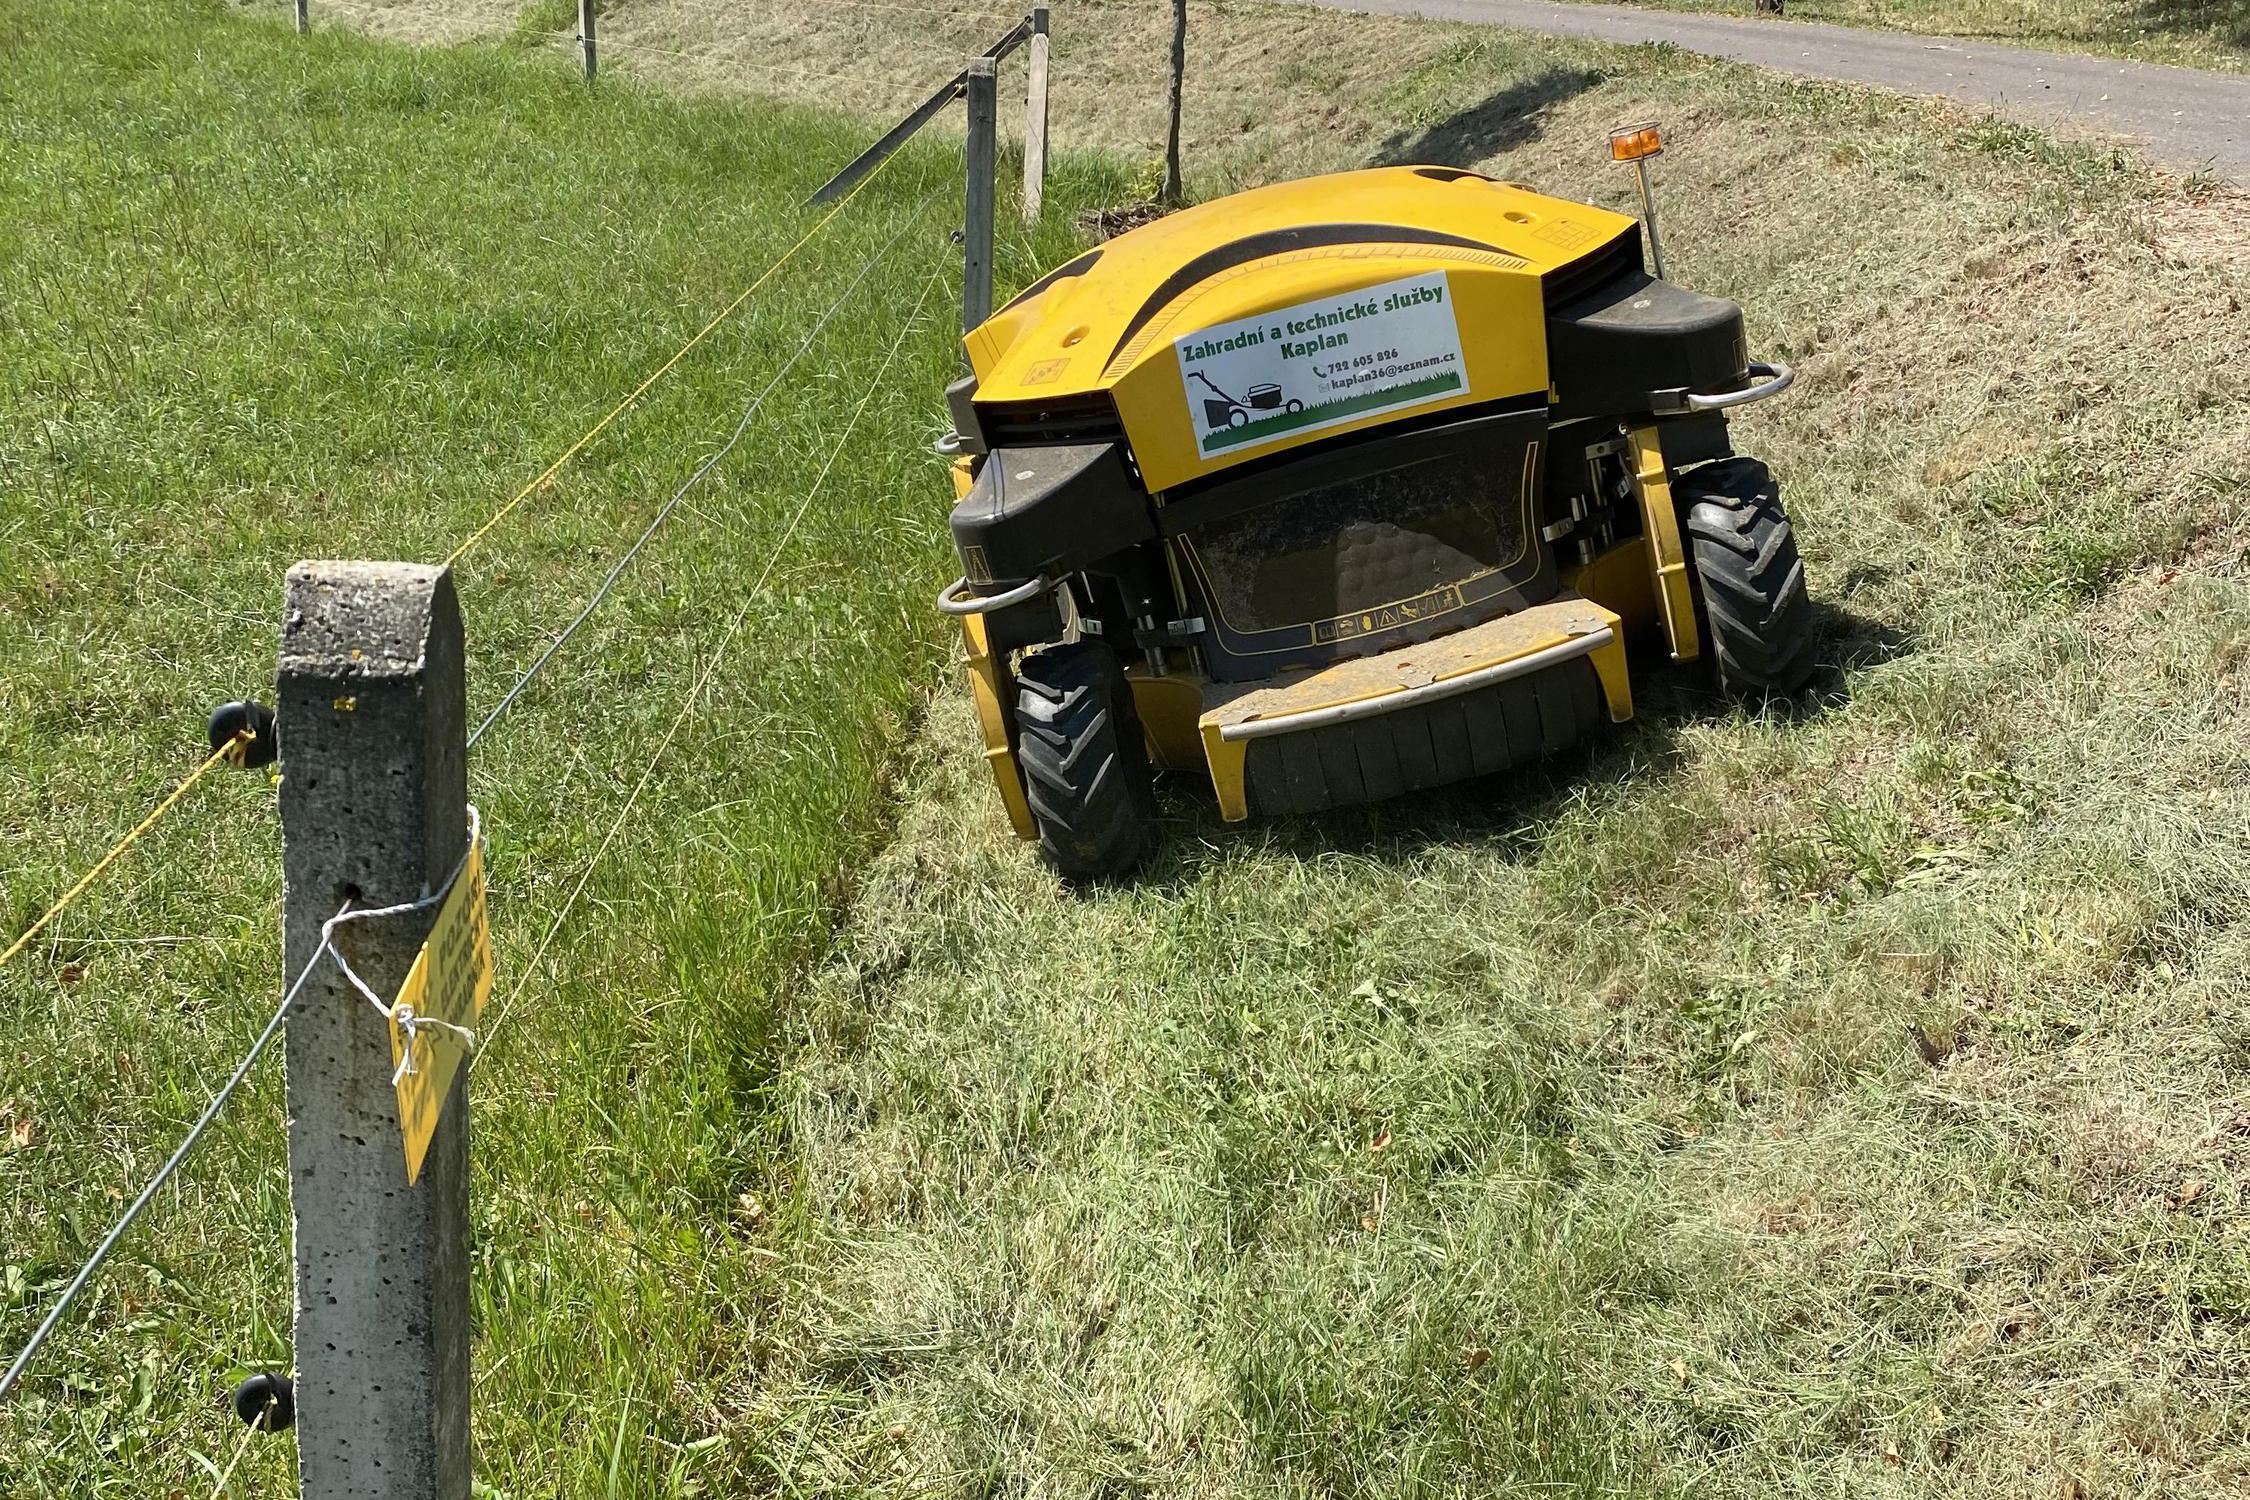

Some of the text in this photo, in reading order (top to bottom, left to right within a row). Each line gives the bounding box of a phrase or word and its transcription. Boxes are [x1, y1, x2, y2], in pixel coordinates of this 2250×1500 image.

[1183, 286, 1443, 362] Zahradní a technické služby
[1280, 332, 1349, 360] Kaplan
[1328, 348, 1399, 375] 722 605 826
[1331, 352, 1456, 391] kaplan36@seznam.cz
